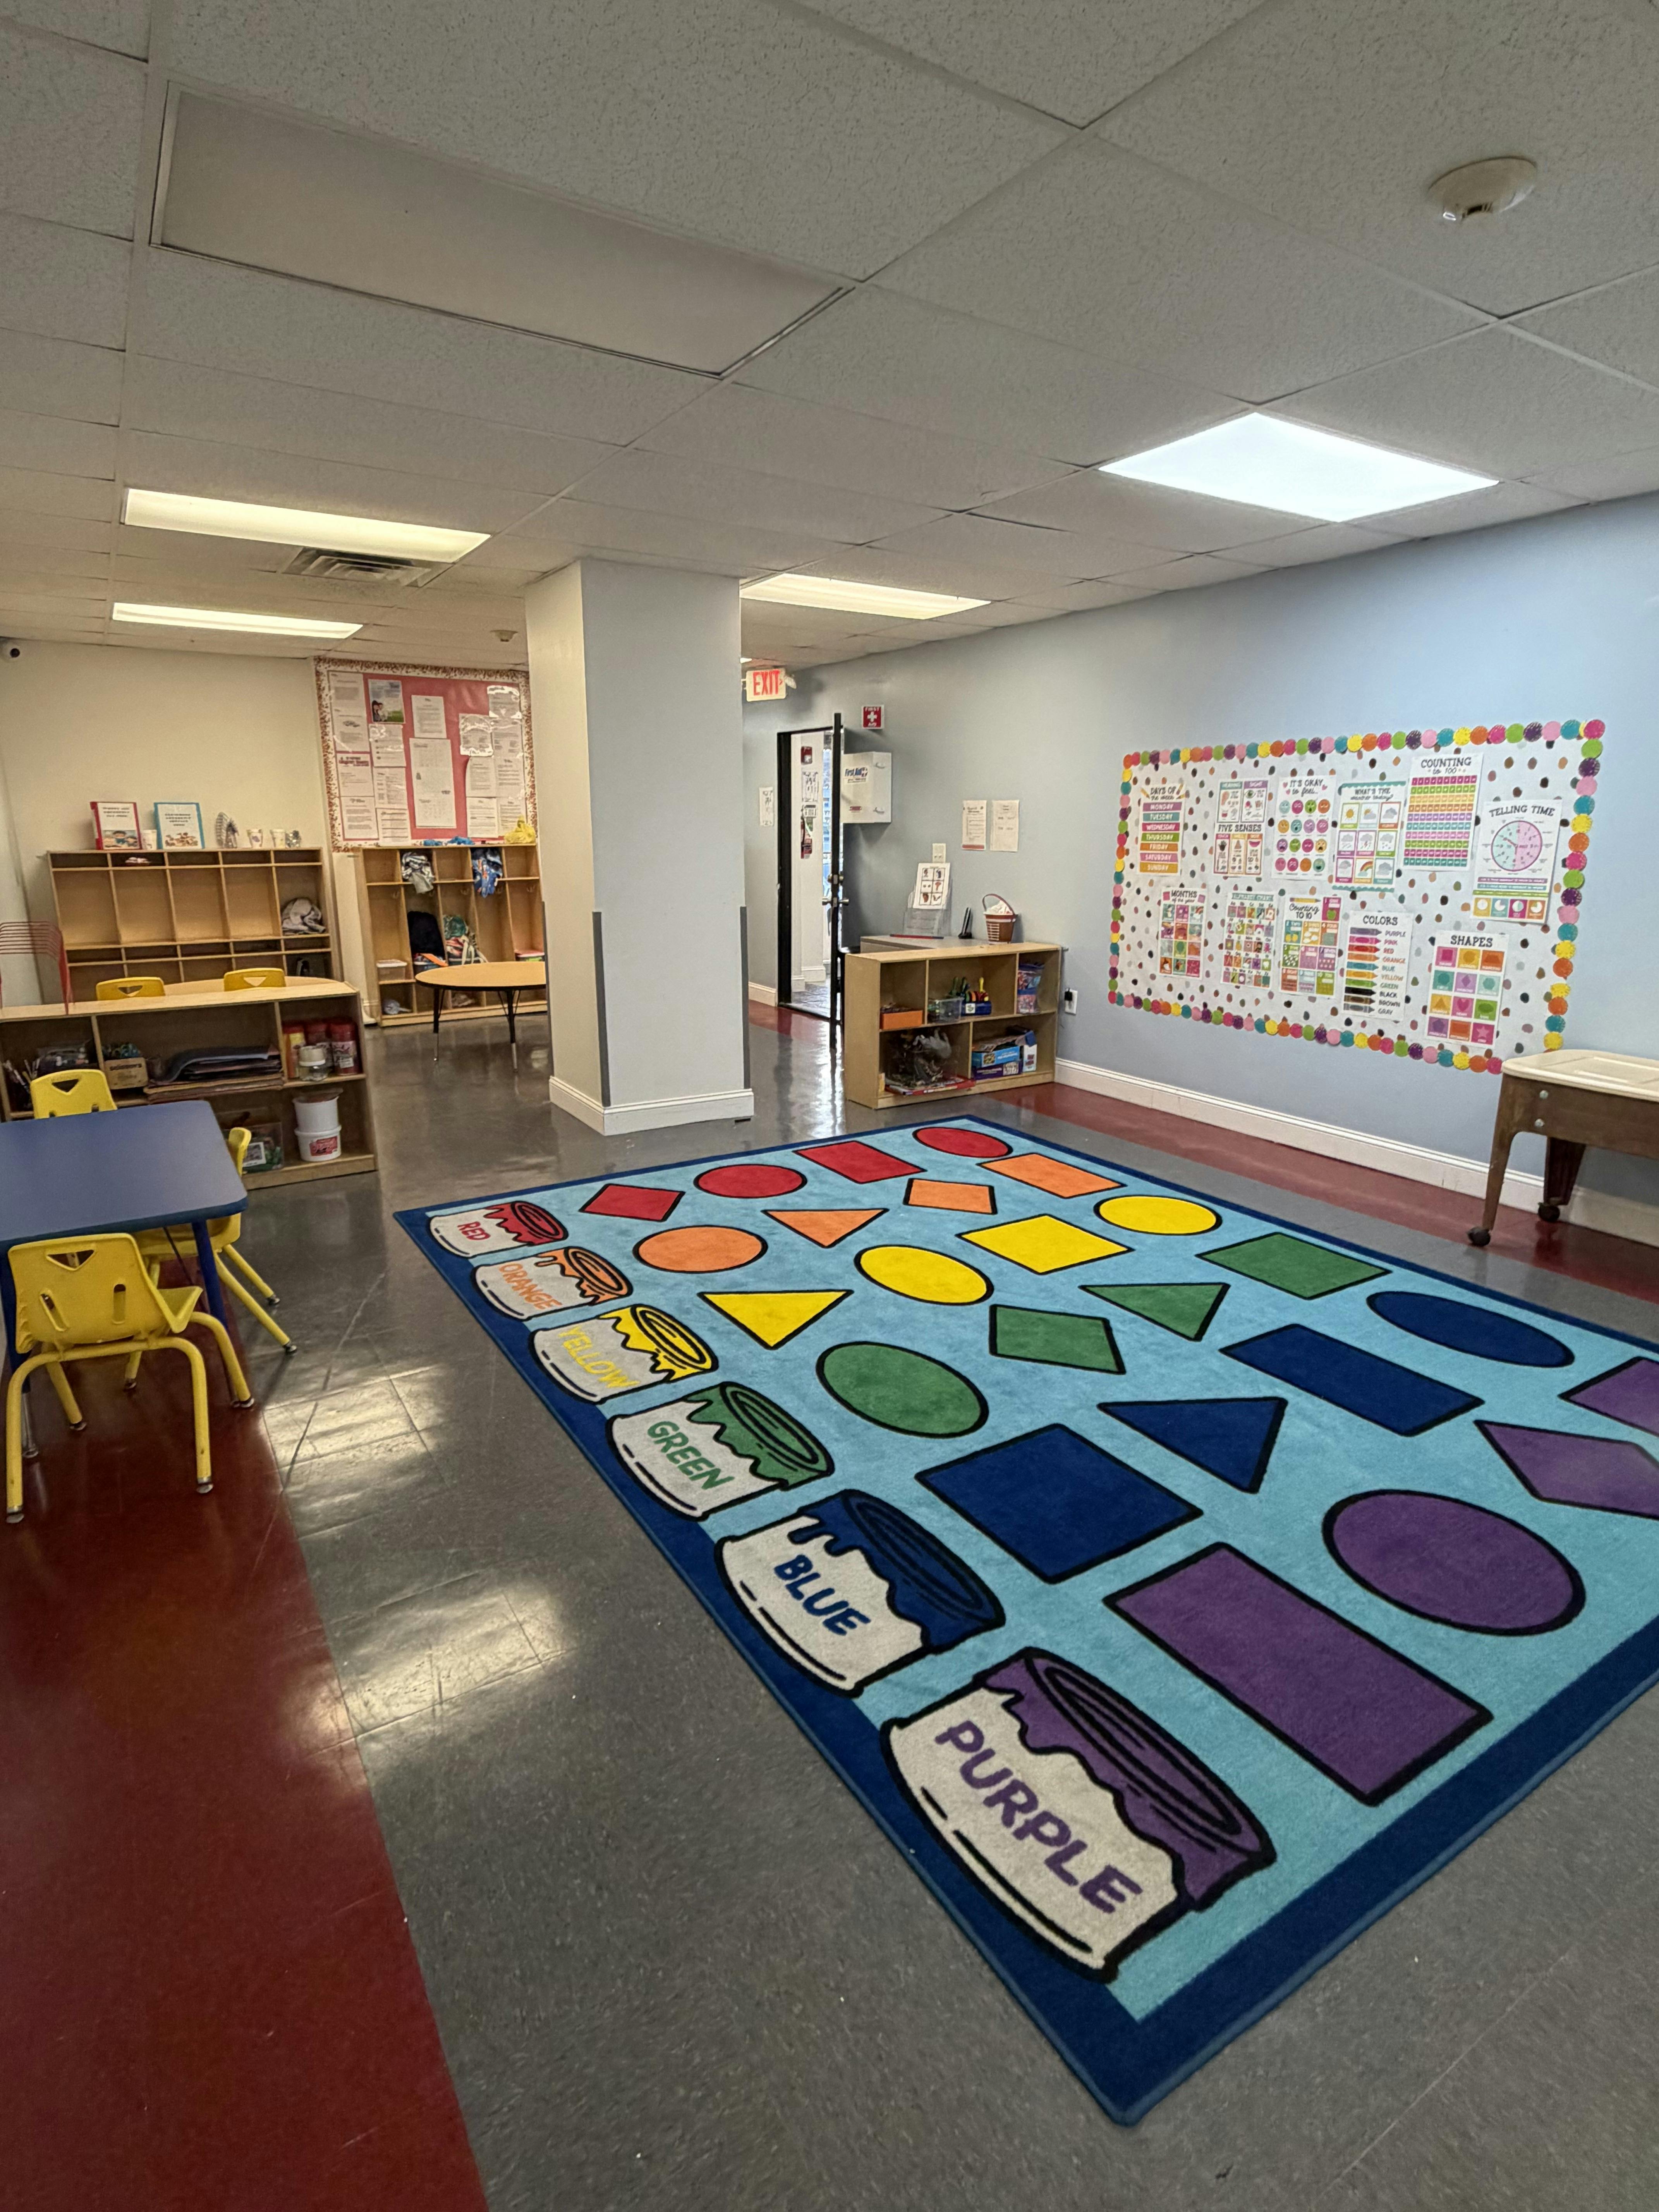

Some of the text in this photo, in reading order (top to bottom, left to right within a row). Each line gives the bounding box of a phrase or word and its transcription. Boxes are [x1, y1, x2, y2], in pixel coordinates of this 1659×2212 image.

[753, 669, 780, 696] EXIT
[1421, 757, 1472, 768] COUNTING
[1150, 787, 1166, 795] DAYS
[1489, 805, 1555, 817] TELLING TIME
[1171, 890, 1197, 898] MONTHS
[1289, 903, 1320, 914] Counting
[1363, 915, 1398, 926] COLORS
[1450, 935, 1493, 948] SHAPES
[457, 1221, 491, 1241] RED
[499, 1262, 563, 1310] ORANGE
[558, 1326, 641, 1389] YELLOW
[647, 1420, 735, 1490] GREEN
[773, 1553, 871, 1637] BLUE
[934, 1720, 1143, 1914] PURPLE
